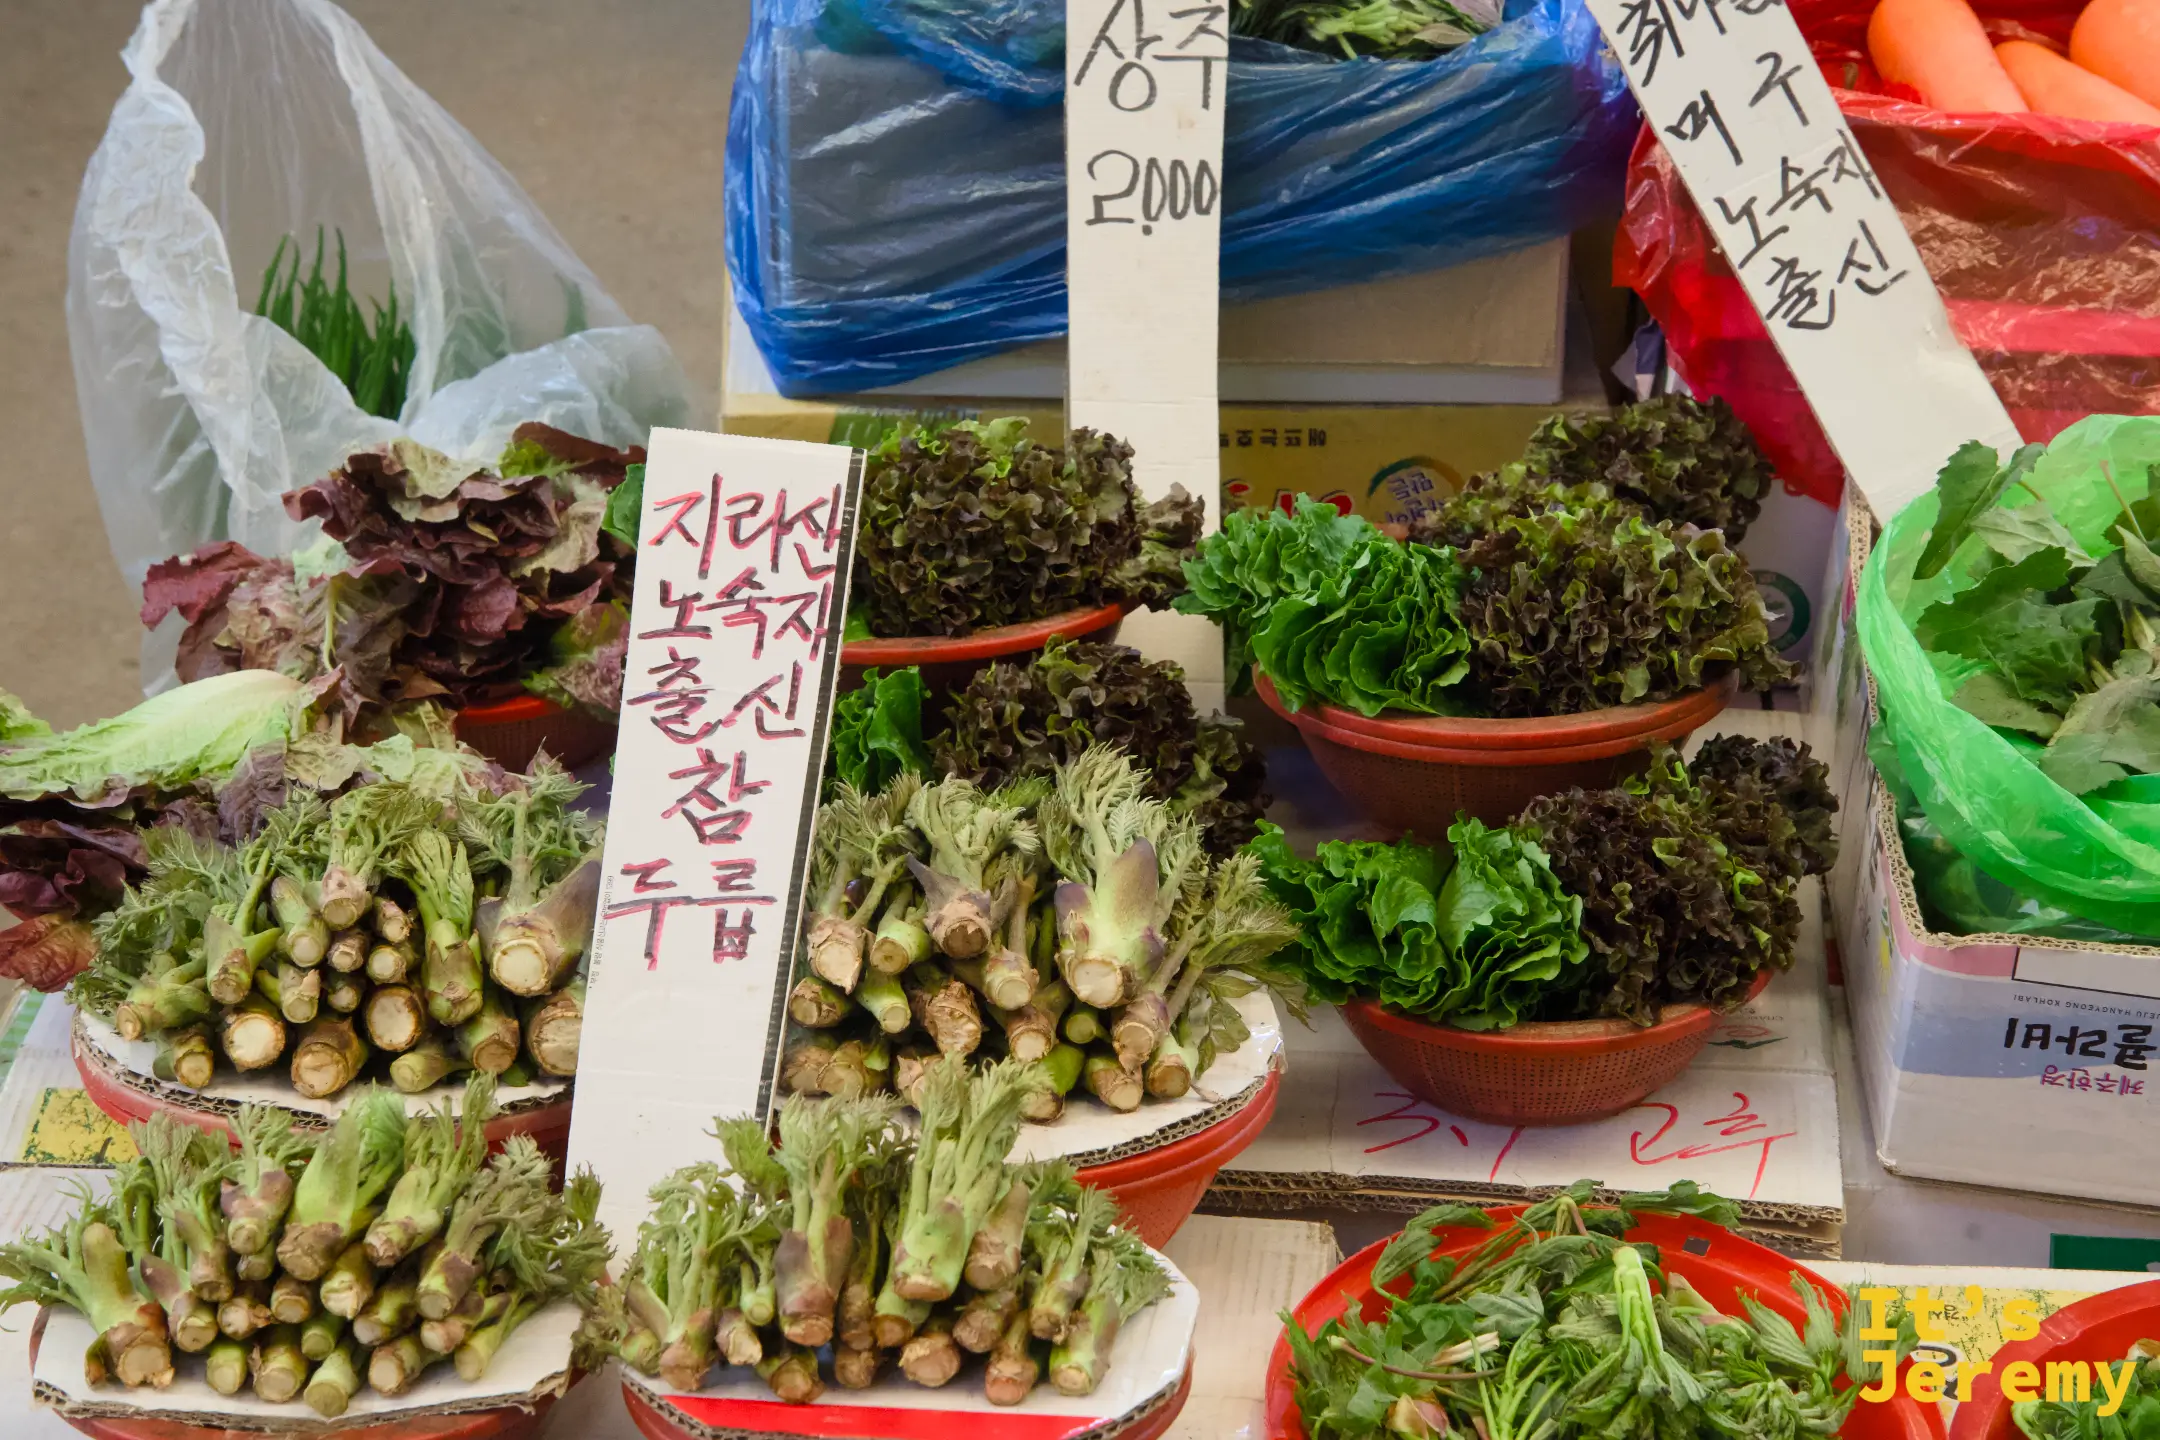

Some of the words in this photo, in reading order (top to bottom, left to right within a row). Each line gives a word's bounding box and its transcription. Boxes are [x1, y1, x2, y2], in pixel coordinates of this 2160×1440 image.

[1714, 128, 1882, 269] 노숙자
[1765, 219, 1909, 330] 출신
[638, 566, 841, 660] 노숙자
[627, 646, 806, 744] 출신
[660, 747, 772, 845] 참
[603, 858, 777, 971] 두릅
[2003, 1018, 2158, 1070] 콜라비
[2065, 1001, 2131, 1016] HANGYEONG
[2040, 1064, 2145, 1096] 제주한경
